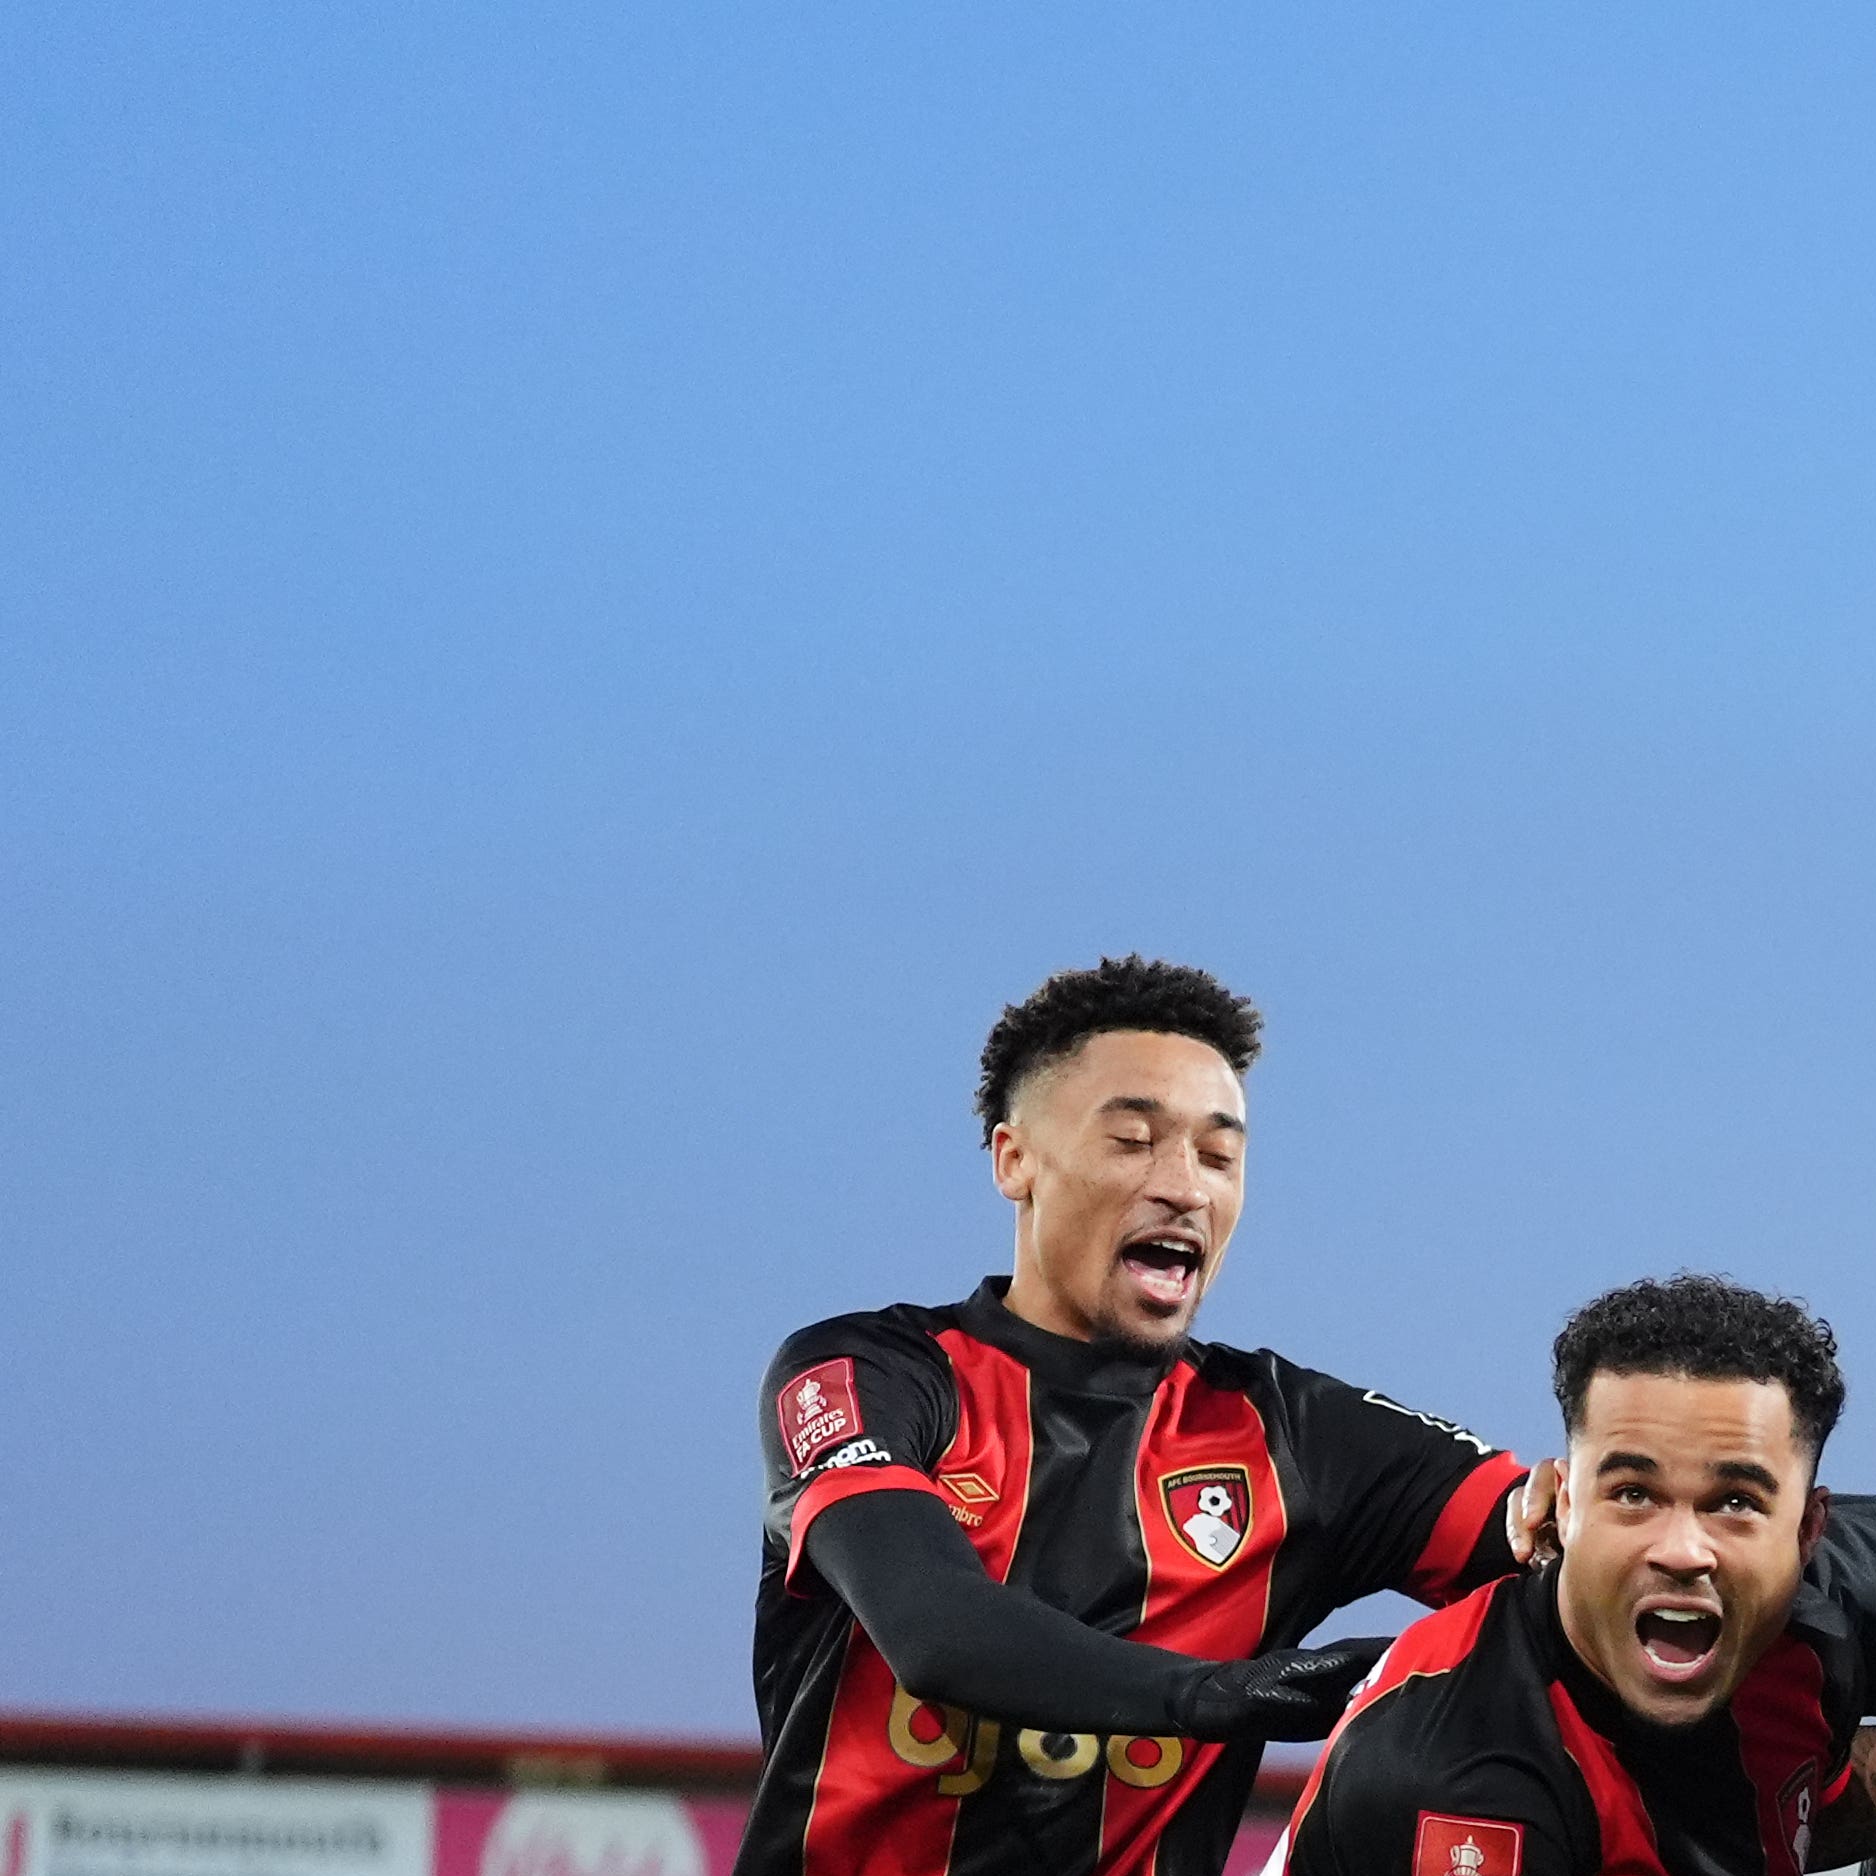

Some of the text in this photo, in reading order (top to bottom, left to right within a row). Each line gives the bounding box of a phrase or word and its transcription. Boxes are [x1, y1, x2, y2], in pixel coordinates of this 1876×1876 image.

[791, 1408, 844, 1450] Emirates
[796, 1440, 812, 1463] FA
[810, 1418, 847, 1445] CUP
[948, 1504, 984, 1527] mbro
